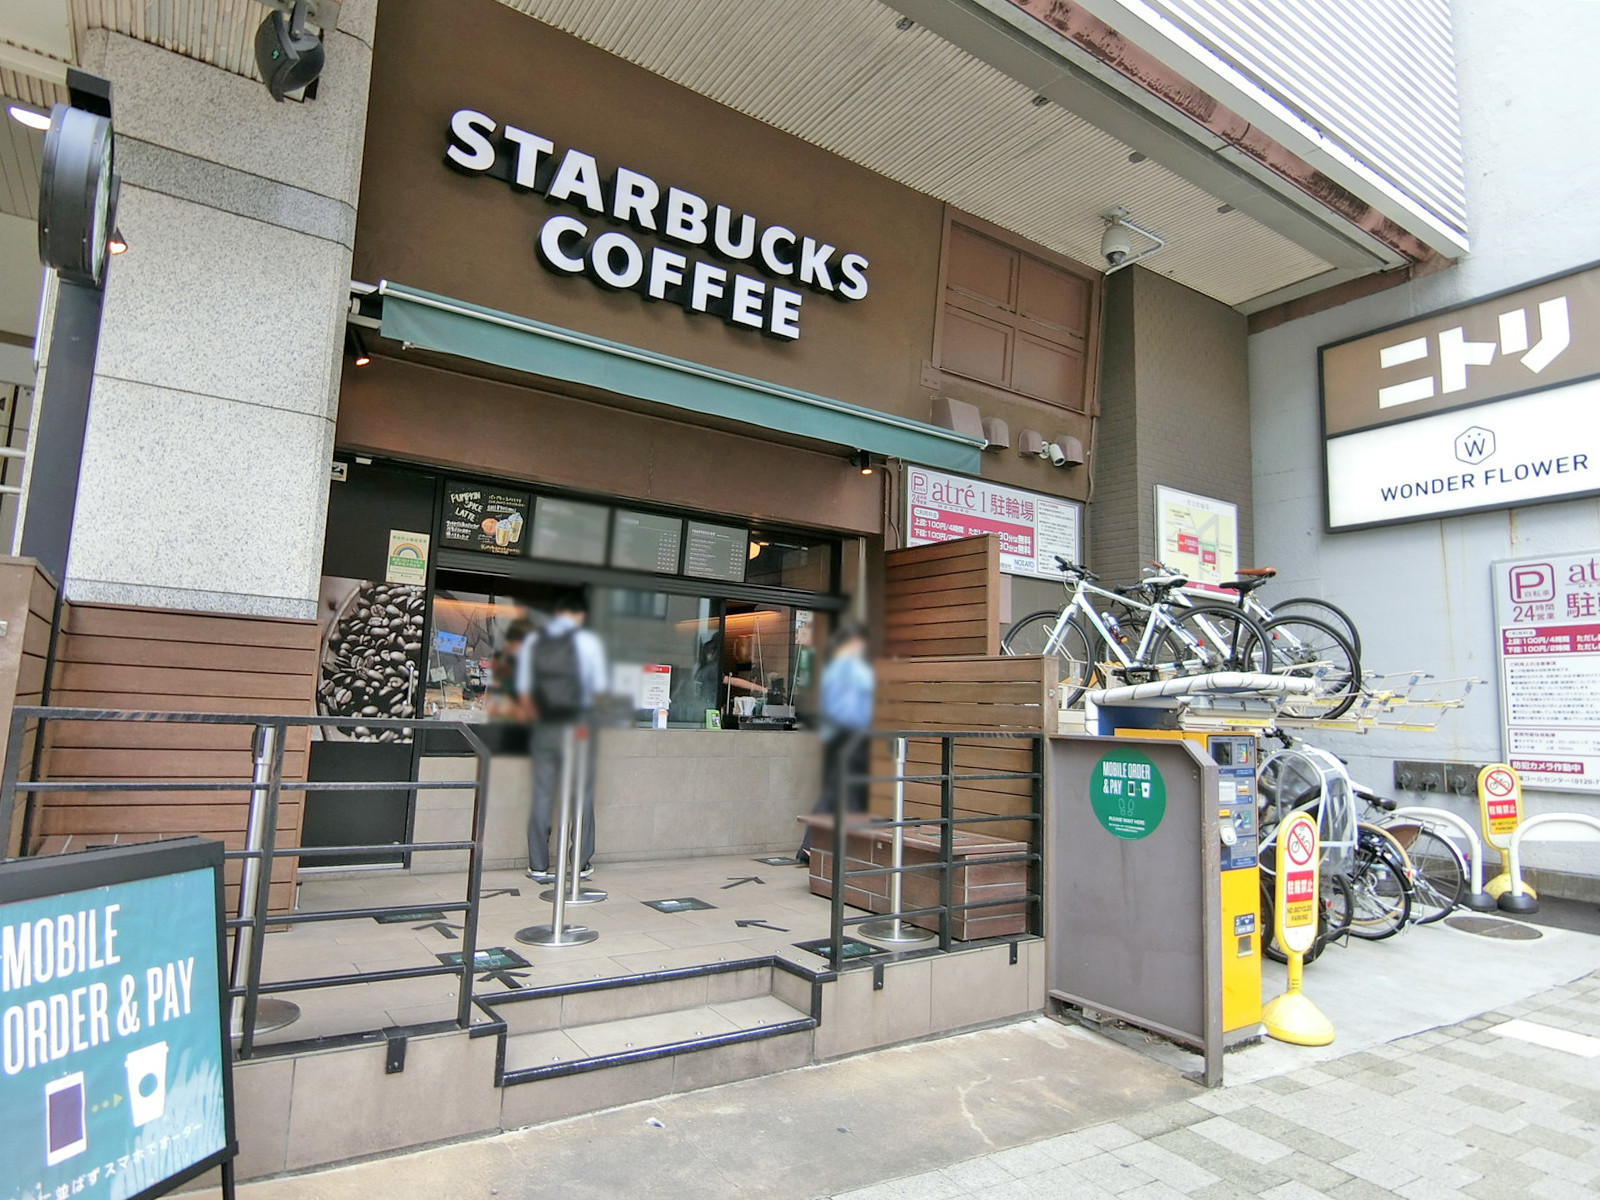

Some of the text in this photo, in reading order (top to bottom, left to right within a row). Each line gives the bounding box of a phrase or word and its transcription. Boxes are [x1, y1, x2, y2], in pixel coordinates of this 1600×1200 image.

[446, 109, 870, 300] STARBUCKS
[539, 214, 803, 340] COFFEE
[1379, 296, 1571, 409] ニトリ
[913, 475, 925, 491] P
[1380, 453, 1590, 502] WONDER FLOWER
[454, 507, 477, 522] LATTE
[464, 500, 484, 513] SPICE
[932, 479, 976, 509] atré
[990, 493, 1034, 522] 駐輪場
[1514, 571, 1545, 599] P
[1512, 604, 1534, 622] 24
[1566, 592, 1600, 618] 駐
[1102, 761, 1151, 780] MOBILE ORDER
[1103, 778, 1122, 795] & PAY
[2, 903, 121, 993] MOBILE
[3, 956, 194, 1075] ORDER & PAY
